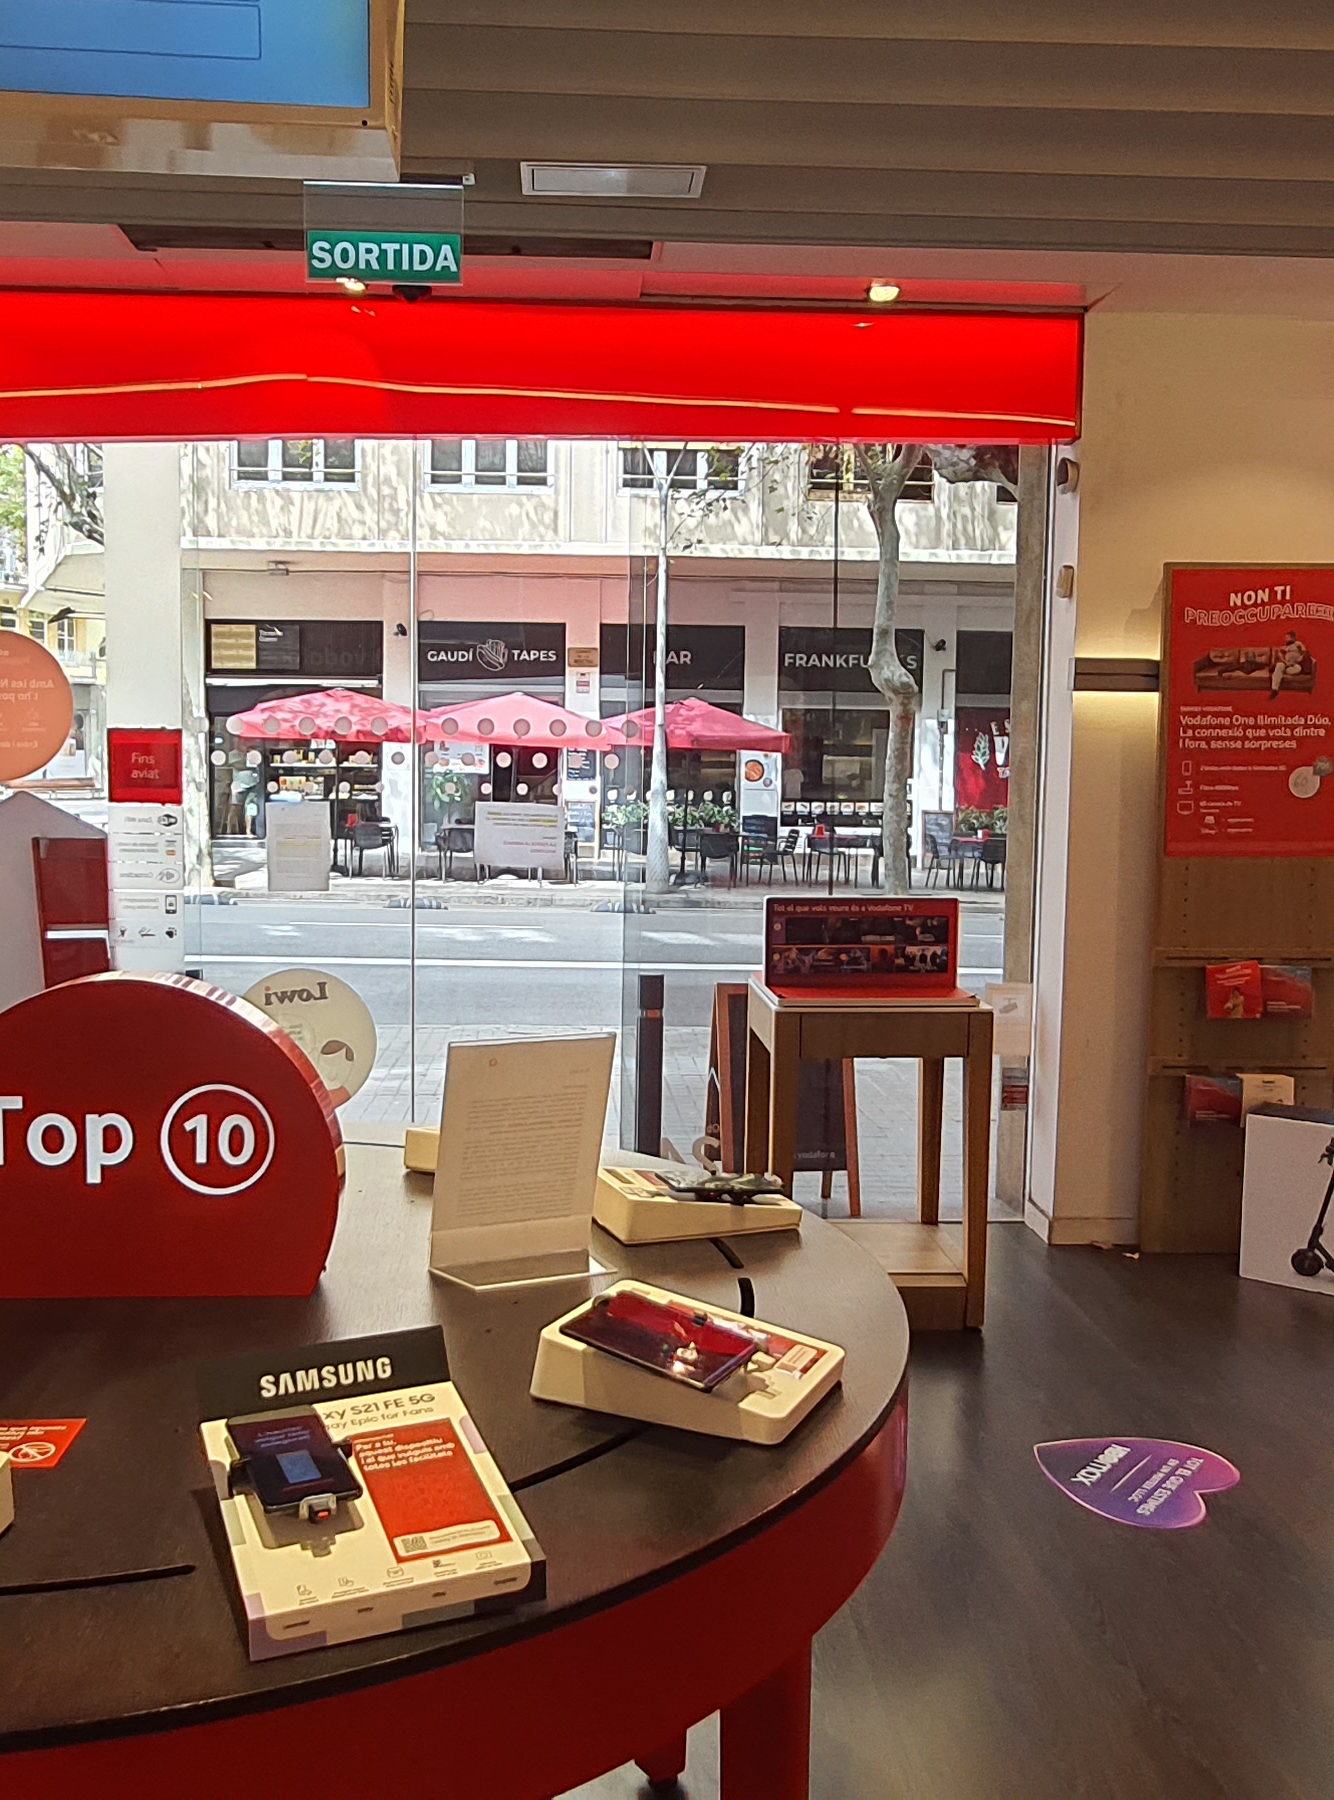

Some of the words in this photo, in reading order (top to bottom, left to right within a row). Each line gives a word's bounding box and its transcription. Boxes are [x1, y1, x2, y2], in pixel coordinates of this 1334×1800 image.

[311, 240, 458, 272] SORTIDA
[1229, 588, 1269, 607] NON
[1274, 585, 1291, 600] TI
[427, 648, 474, 662] GAUDÍ
[511, 650, 557, 662] TAPES
[653, 650, 692, 666] AR
[1179, 714, 1230, 725] Vodafone
[1232, 714, 1255, 725] One
[1179, 727, 1193, 737] La
[1195, 726, 1244, 737] connexió
[1246, 728, 1266, 739] que
[1268, 726, 1292, 737] vols
[1293, 726, 1327, 737] dintre
[1210, 740, 1243, 749] sense
[1244, 739, 1297, 751] sorpreses
[131, 752, 155, 764] Fins
[131, 768, 160, 780] aviat
[773, 904, 785, 912] Tot
[787, 904, 794, 912] el
[796, 905, 809, 914] que
[811, 904, 827, 912] vols
[867, 904, 902, 913] Vodafone
[903, 904, 915, 912] TV
[182, 1113, 257, 1167] 10
[259, 1356, 393, 1399] SAMSUNG
[350, 1403, 380, 1416] S21
[383, 1397, 405, 1410] FE
[408, 1393, 436, 1405] 5G
[351, 1415, 379, 1426] Epic
[380, 1412, 399, 1420] for
[403, 1407, 434, 1418] Fans
[1189, 1456, 1204, 1471] TOT
[1177, 1466, 1192, 1478] EL
[1164, 1475, 1184, 1491] QUE
[1136, 1488, 1172, 1517] ESTIMES
